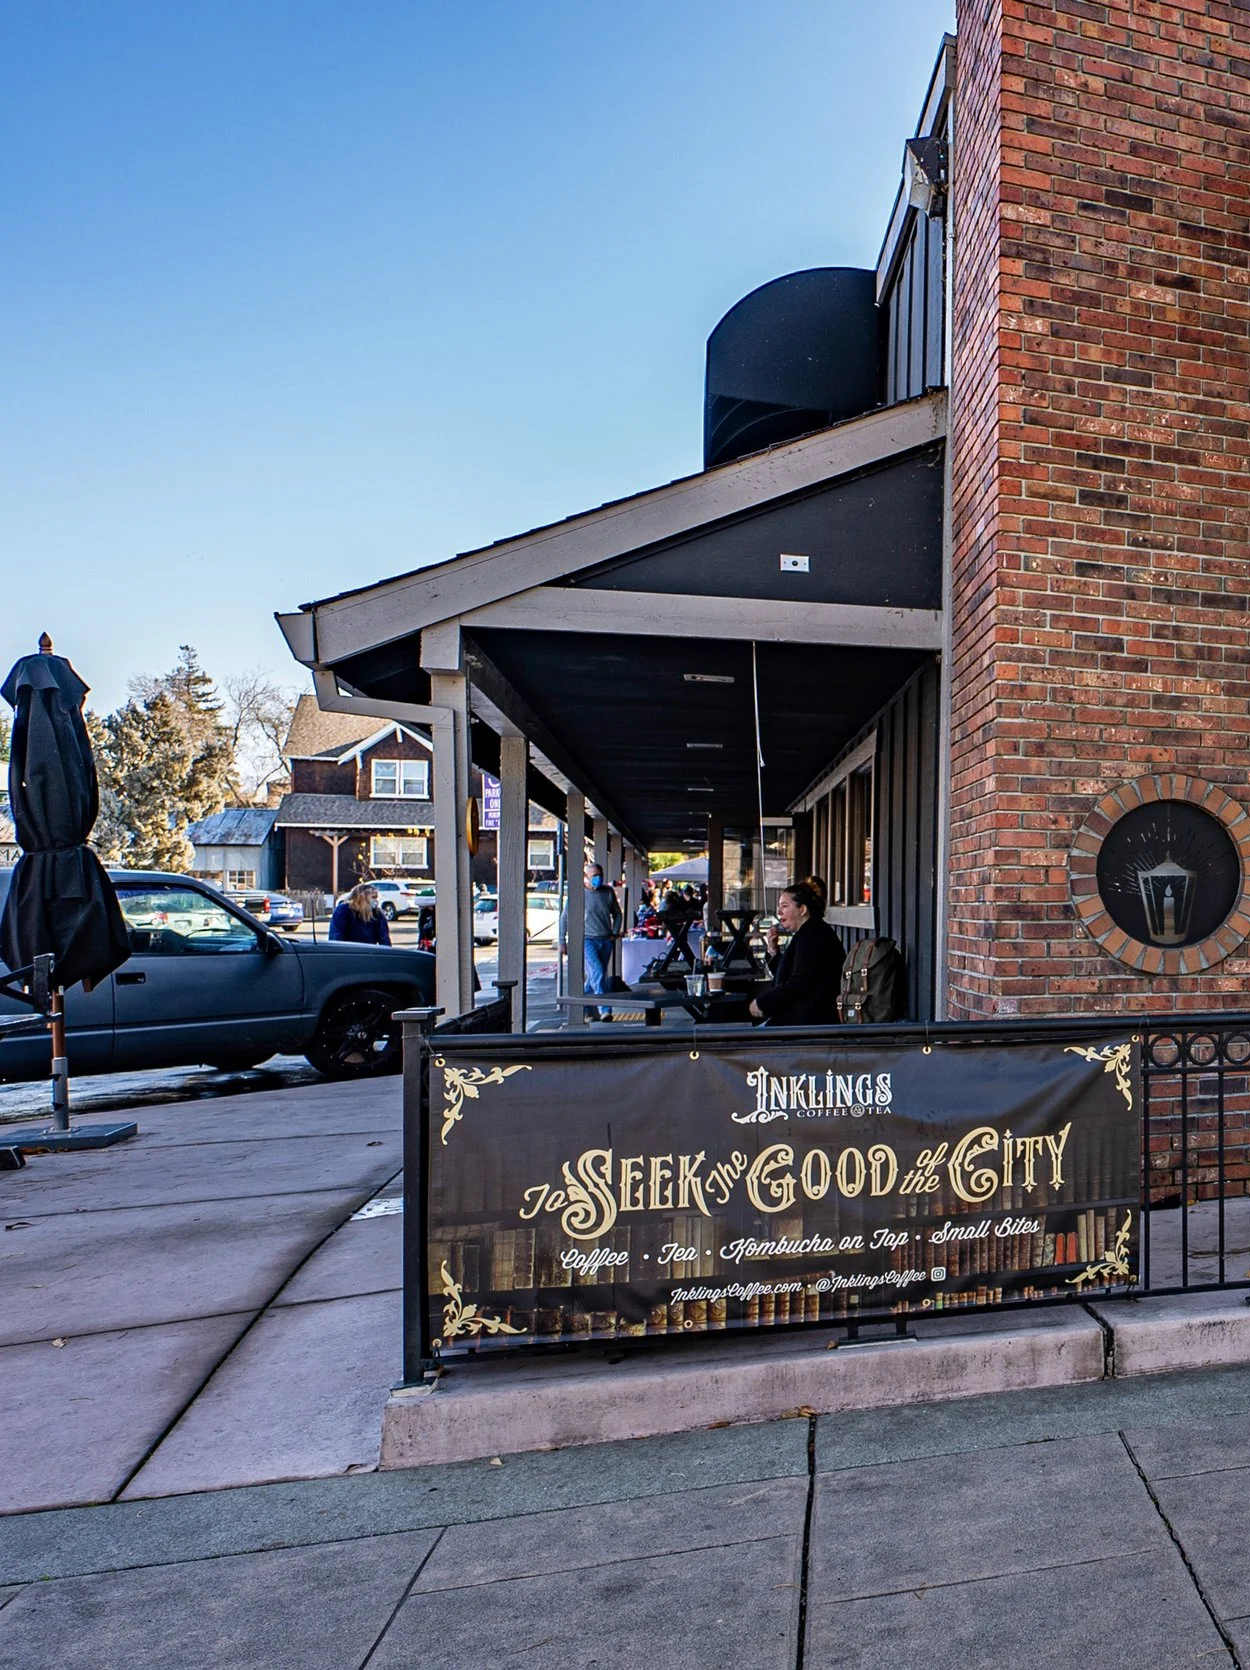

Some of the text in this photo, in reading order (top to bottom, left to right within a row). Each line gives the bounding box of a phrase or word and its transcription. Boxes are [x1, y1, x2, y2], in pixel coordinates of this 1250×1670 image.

[731, 1065, 893, 1124] INKLINGS
[796, 1108, 849, 1119] COFFEE
[866, 1105, 892, 1115] TEA
[745, 1143, 899, 1213] GOOD
[899, 1169, 941, 1195] the
[916, 1142, 949, 1177] of
[946, 1121, 1073, 1203] CITY
[519, 1183, 568, 1219] To
[561, 1148, 712, 1240] SEEK
[560, 1216, 1041, 1276] Coffee Tea Kombucha on Tap Small Bites
[670, 1269, 927, 1306] InklingsCoffee.com @InklingsCoffee
